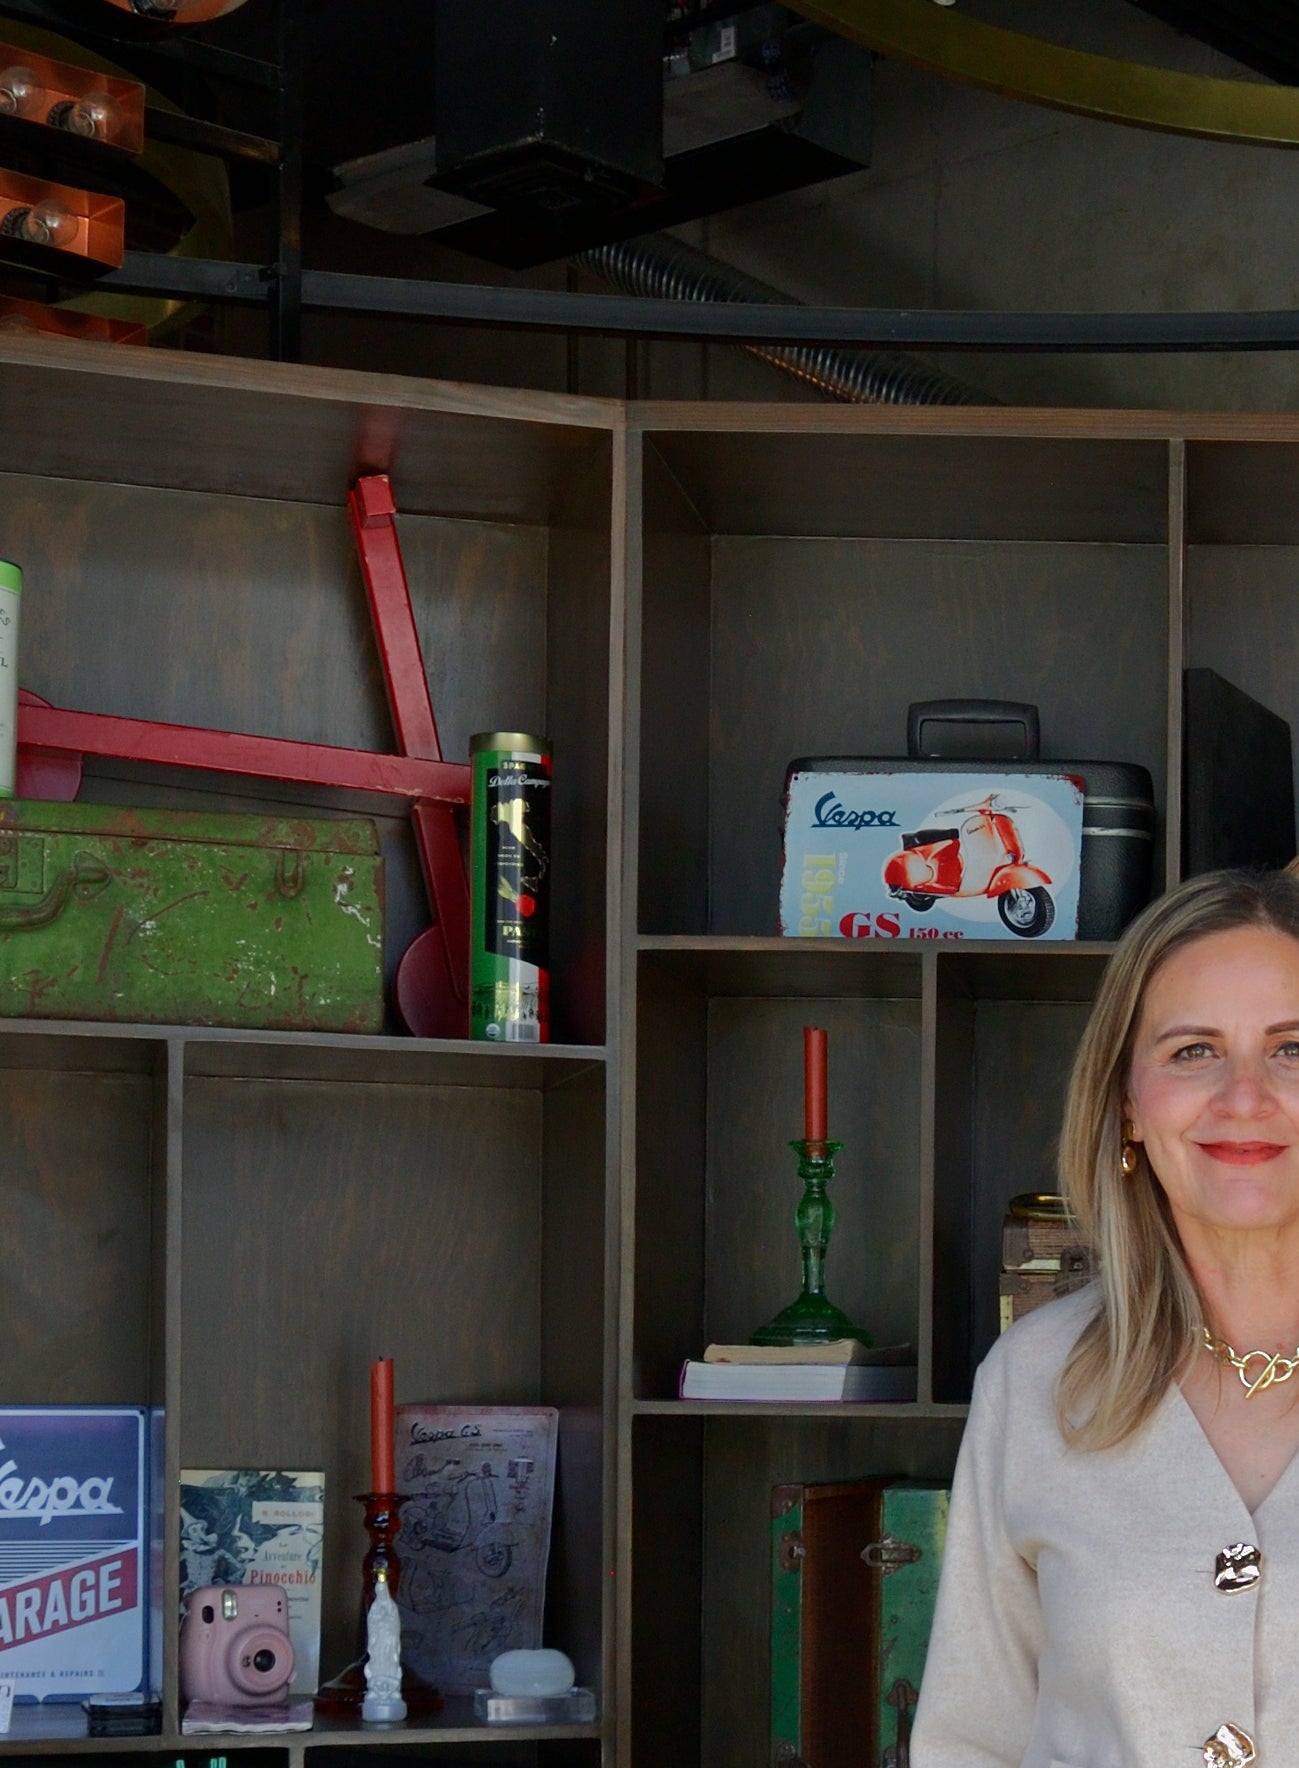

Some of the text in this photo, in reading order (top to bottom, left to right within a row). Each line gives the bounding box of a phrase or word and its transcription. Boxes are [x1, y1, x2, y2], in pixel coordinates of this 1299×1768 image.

[811, 791, 901, 831] Vespa
[799, 853, 836, 939] 1955
[839, 911, 900, 939] GS
[410, 1422, 456, 1446] Vespa
[250, 1569, 317, 1585] Pinocchio
